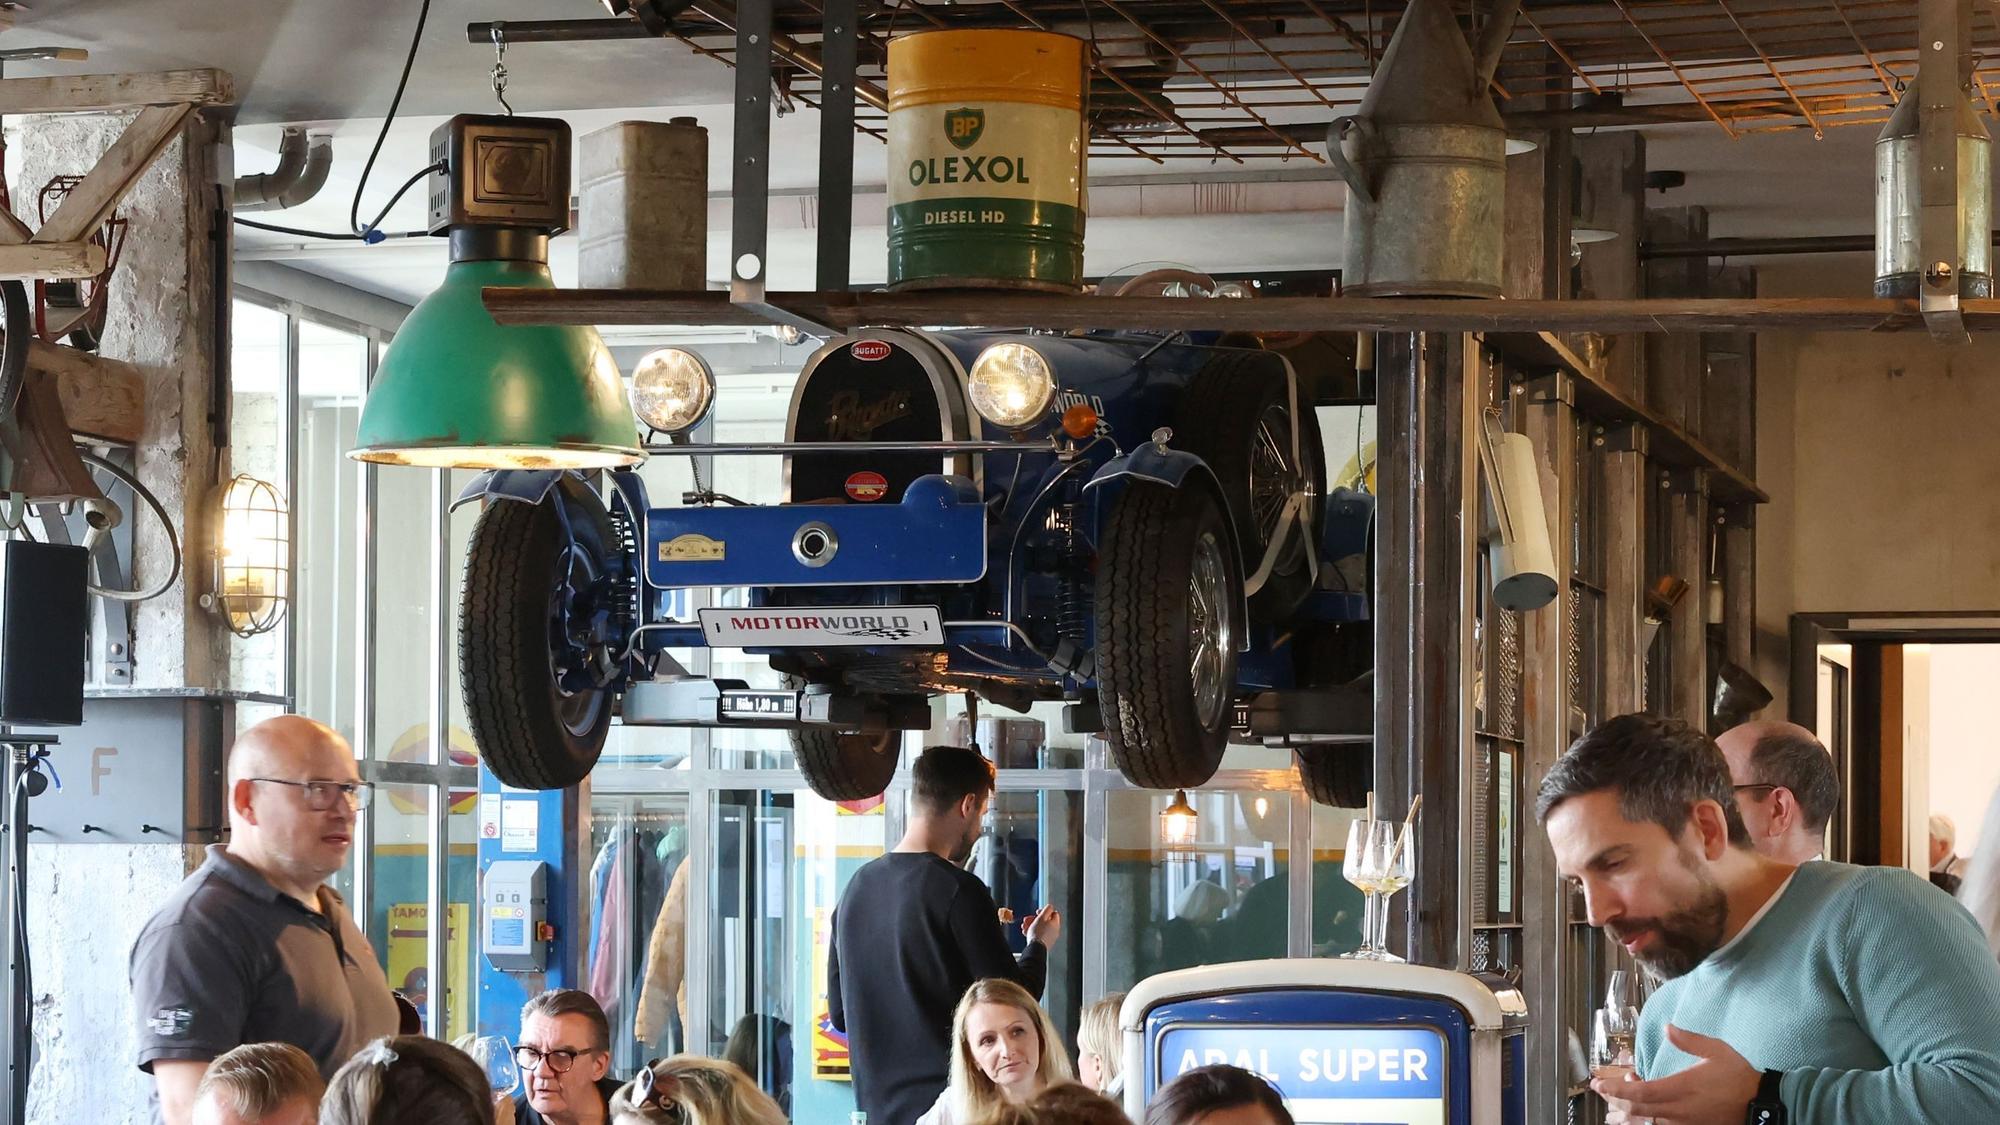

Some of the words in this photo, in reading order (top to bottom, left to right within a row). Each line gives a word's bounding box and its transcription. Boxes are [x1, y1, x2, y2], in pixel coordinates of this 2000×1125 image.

[951, 116, 979, 138] BP
[909, 156, 1030, 187] OLEXOL
[925, 210, 976, 225] DIESEL
[981, 210, 1005, 224] HD
[854, 347, 888, 355] BUGATTI
[730, 616, 910, 630] MOTORWORLD
[91, 747, 119, 796] F
[1299, 1048, 1429, 1082] SUPER
